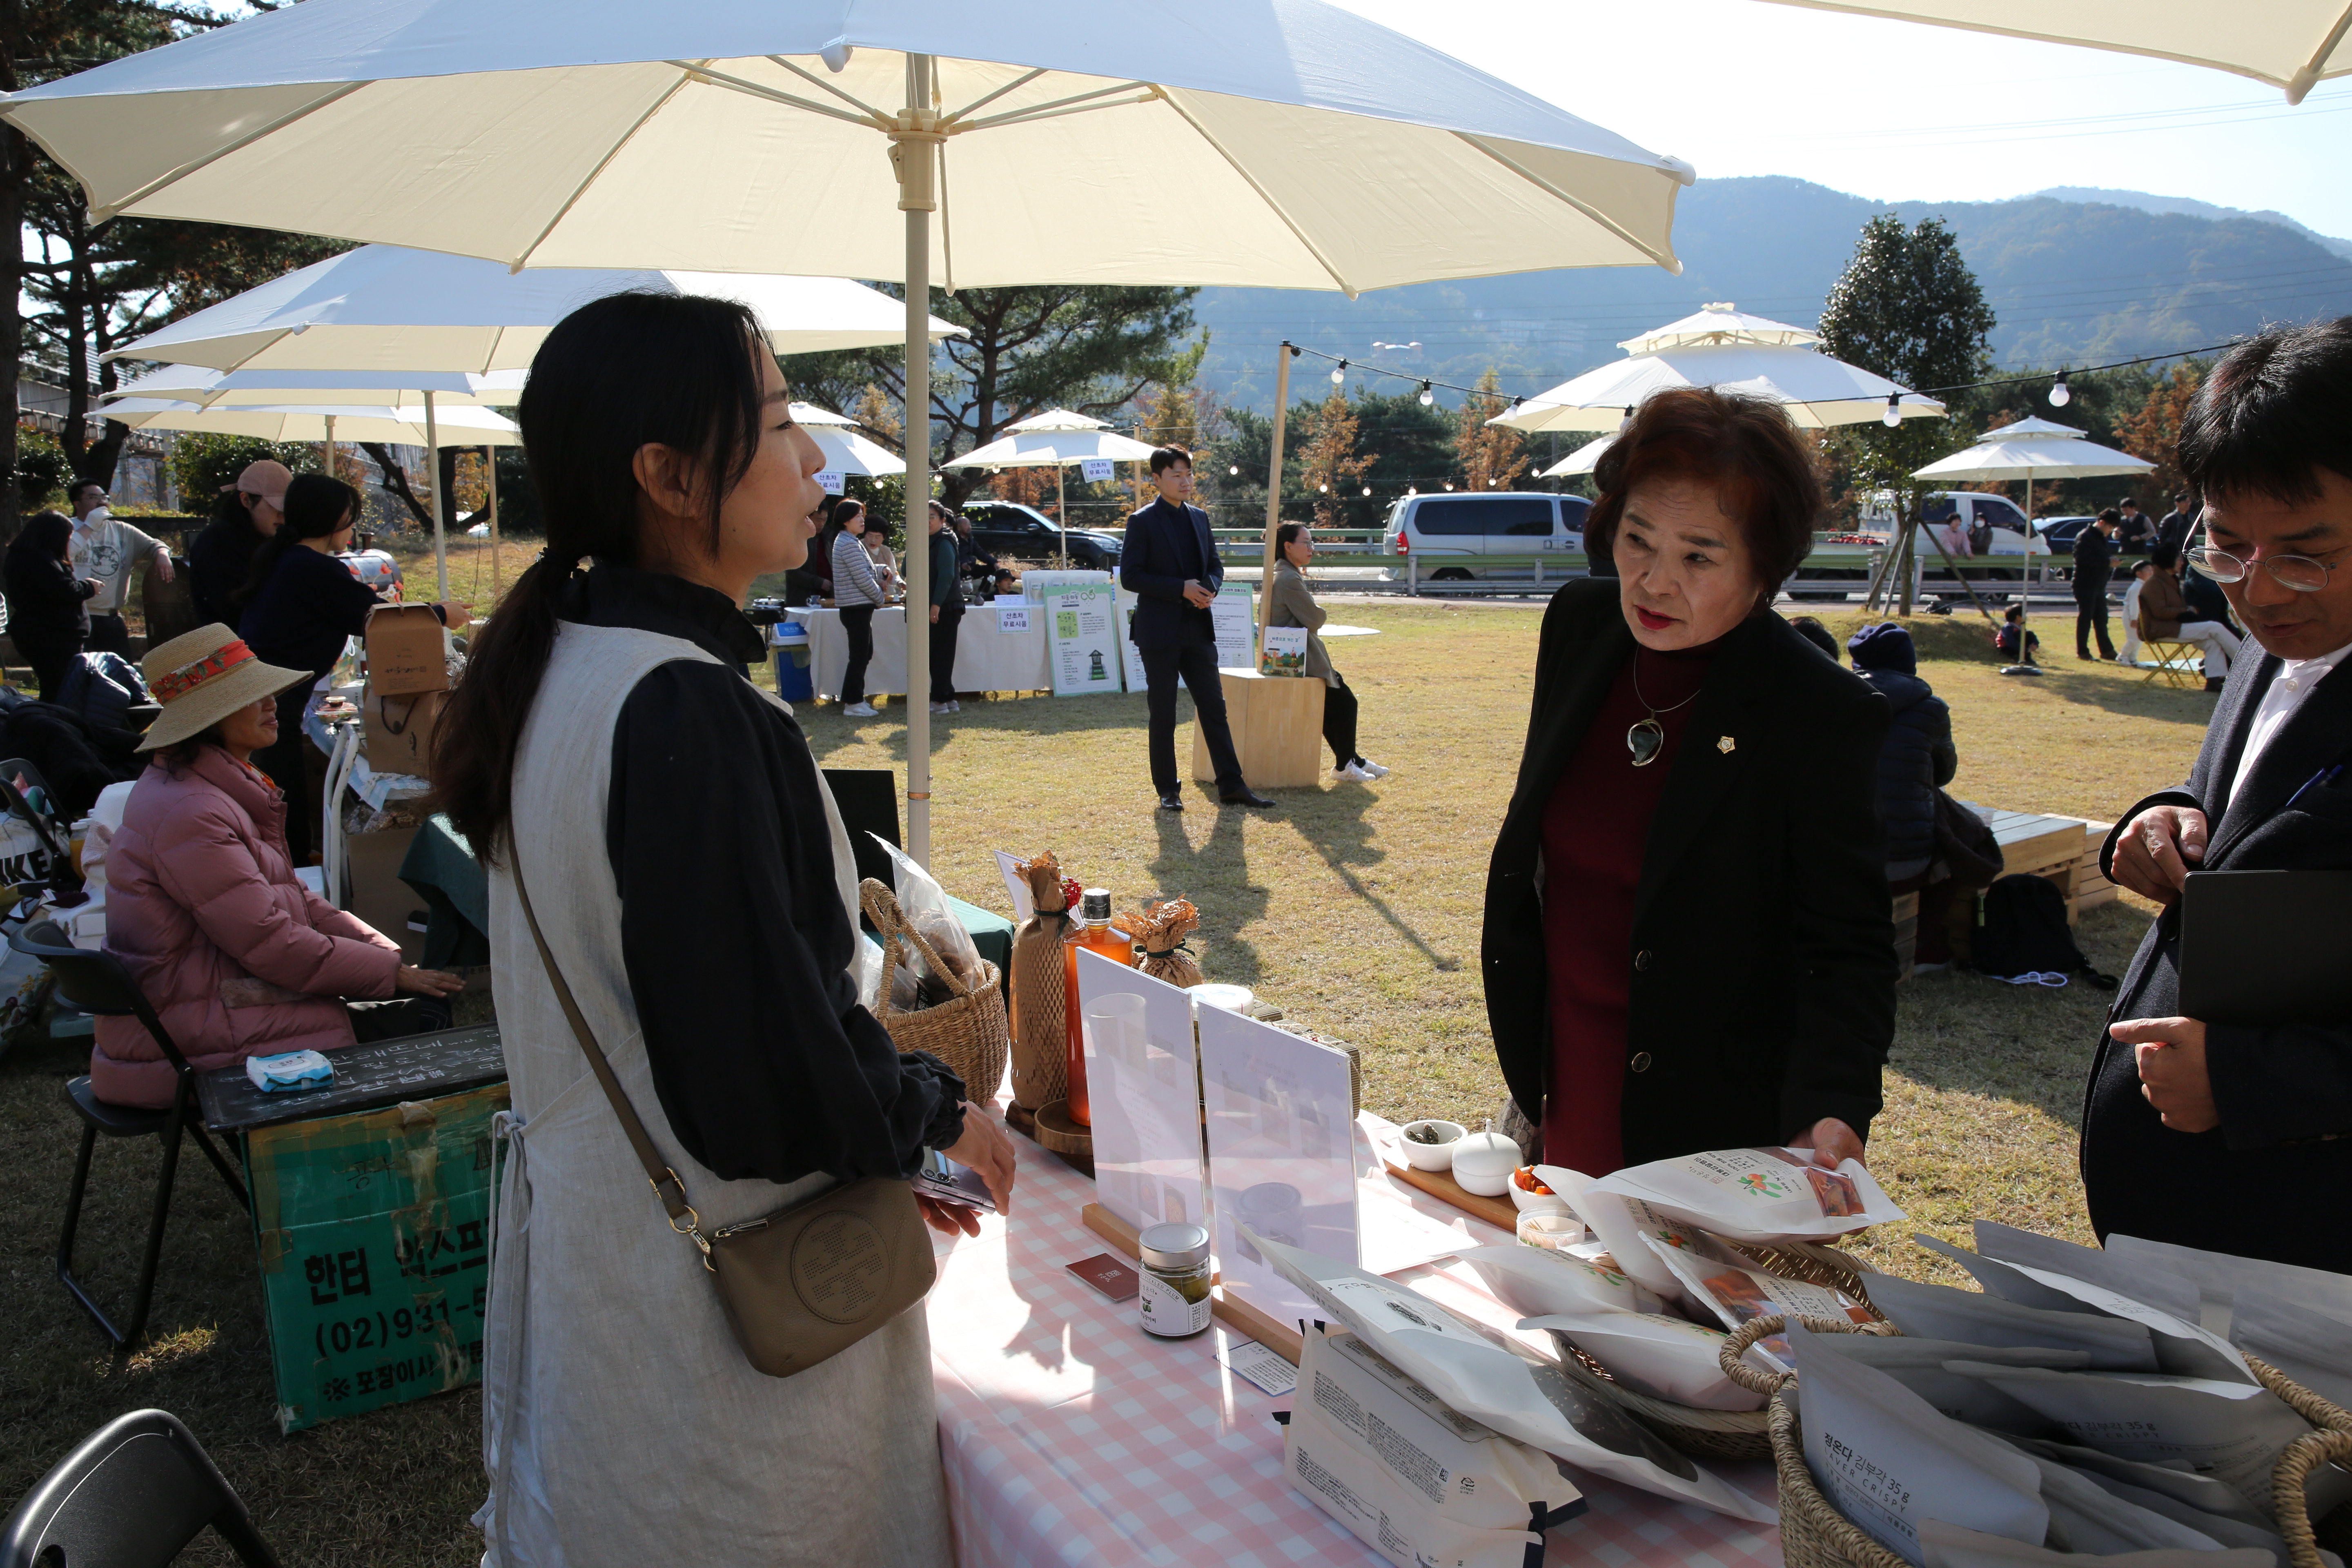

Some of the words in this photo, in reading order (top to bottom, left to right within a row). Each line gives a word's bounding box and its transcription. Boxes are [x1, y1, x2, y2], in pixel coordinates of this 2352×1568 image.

[0, 849, 51, 887] IKE
[304, 1247, 371, 1306] 한터
[394, 1217, 491, 1283] 익스프
[1145, 1275, 1164, 1290] PICKLED
[1165, 1288, 1180, 1301] PLUM
[356, 1354, 434, 1395] 포장이사
[2126, 1421, 2143, 1430] 35
[1824, 1432, 1853, 1462] 정온다
[1855, 1455, 1887, 1485] 김부각
[1887, 1479, 1902, 1494] 35
[1825, 1446, 1855, 1478] LAVER
[1862, 1479, 1906, 1513] CRISPY
